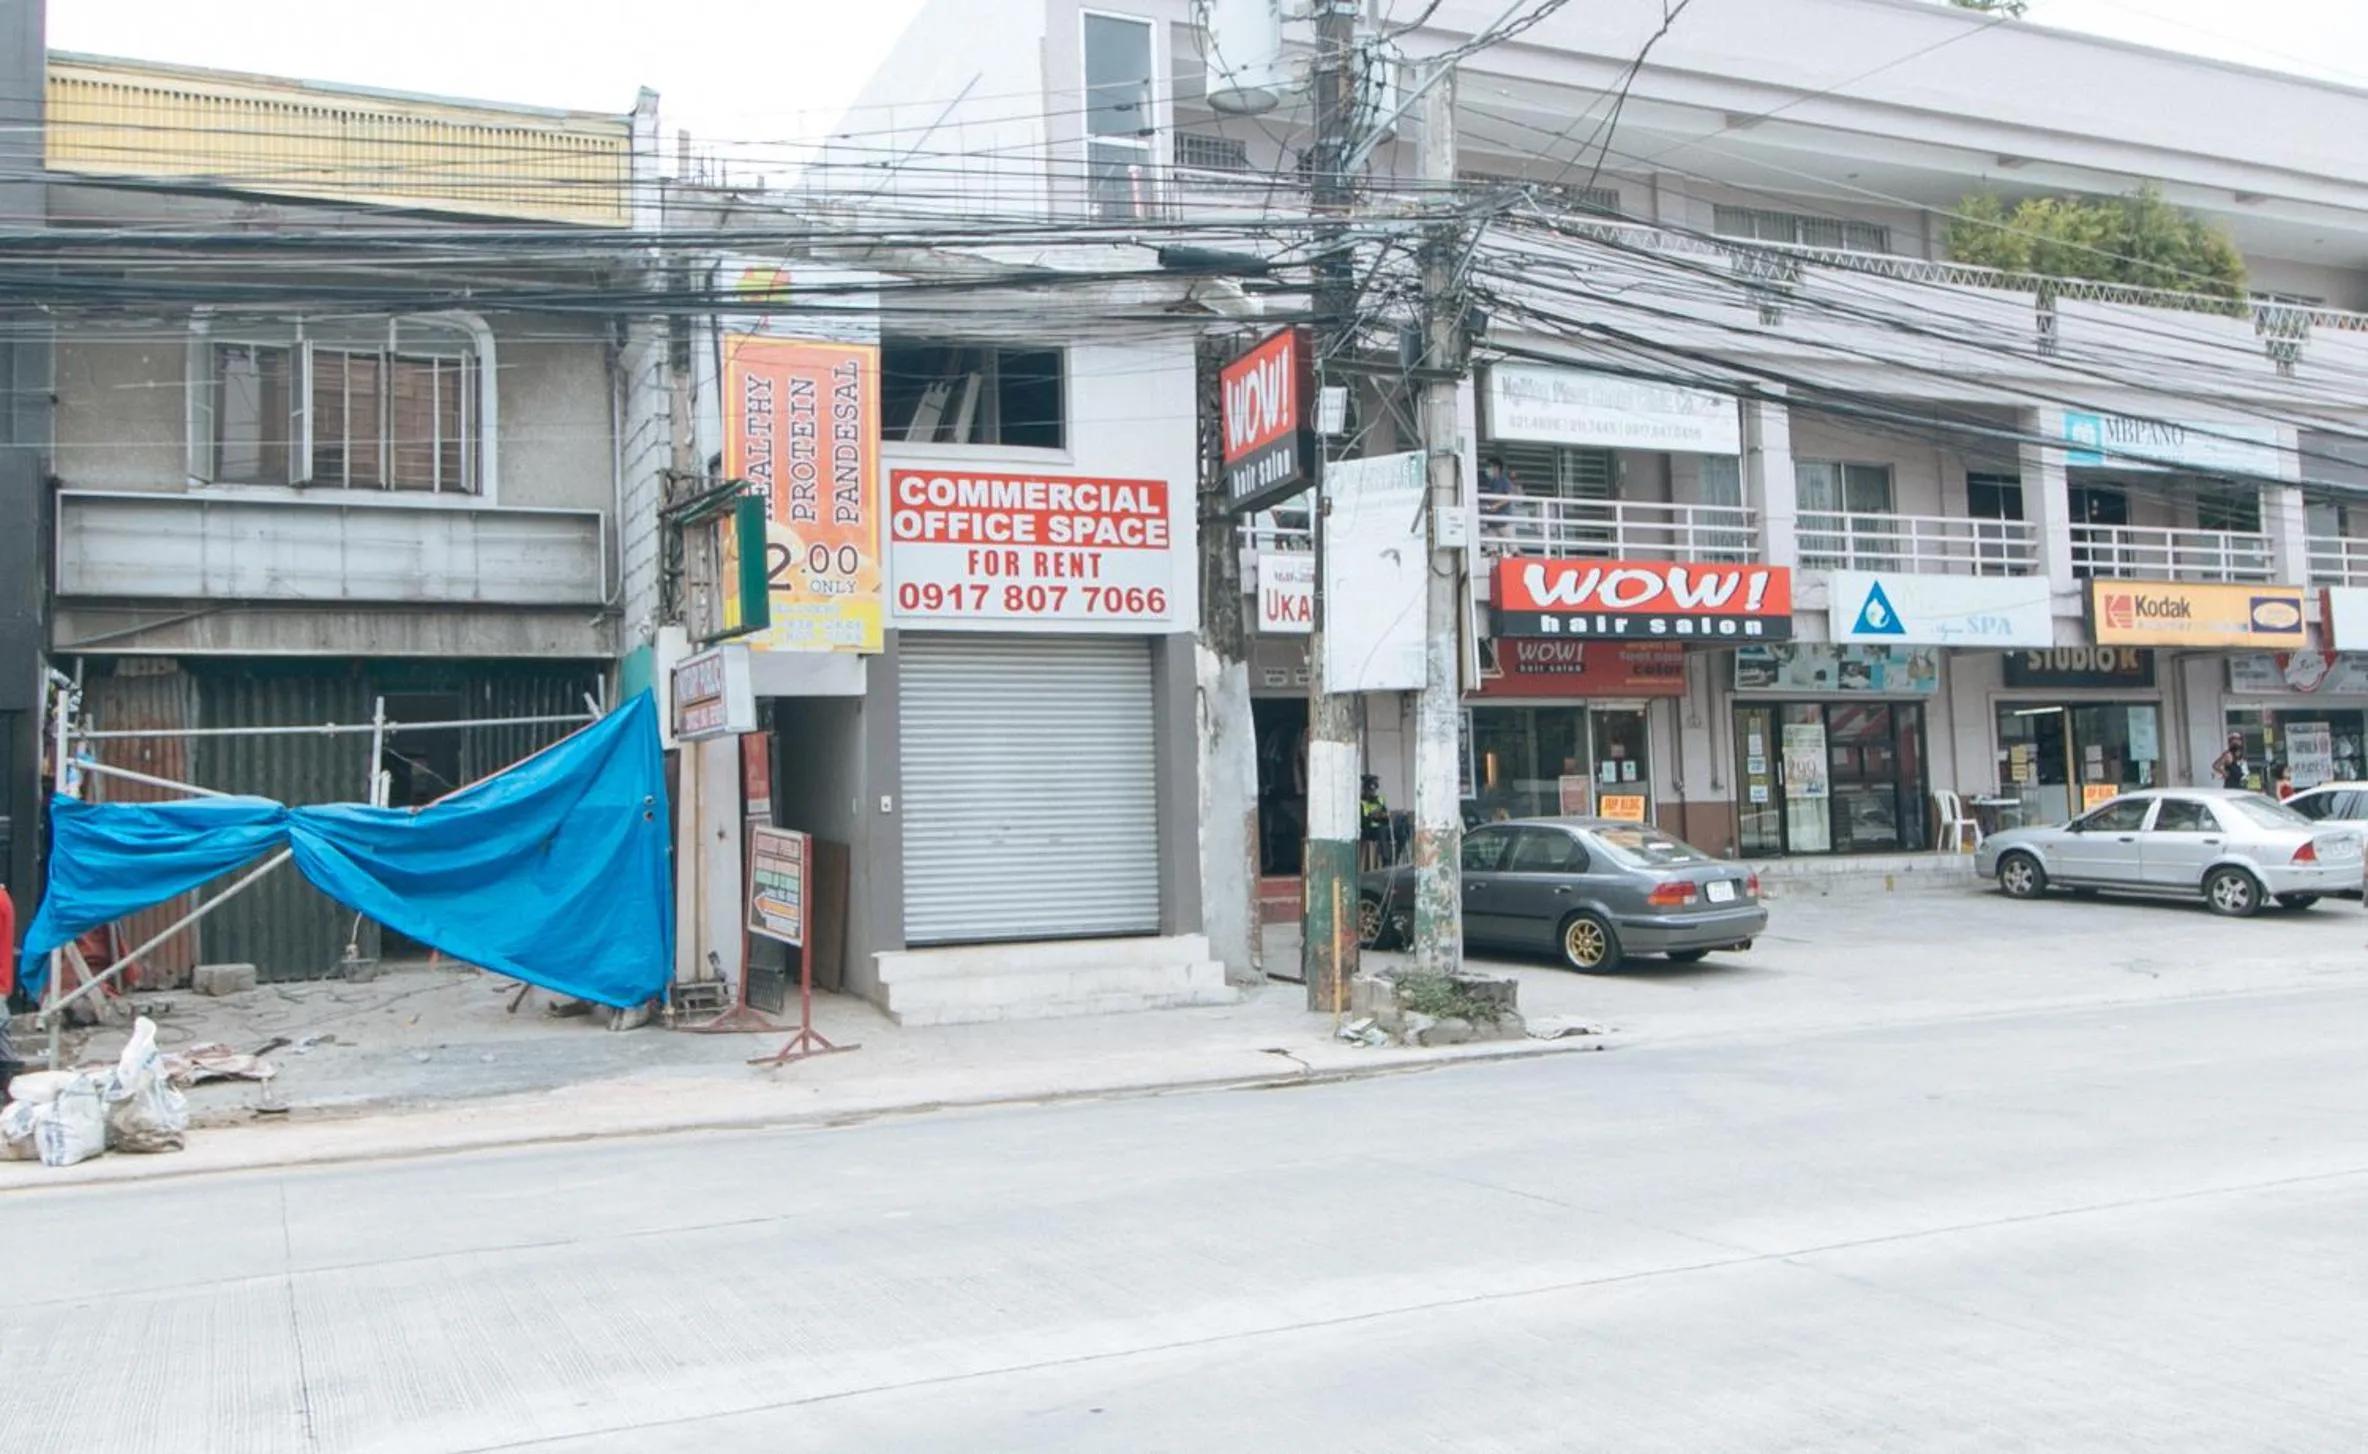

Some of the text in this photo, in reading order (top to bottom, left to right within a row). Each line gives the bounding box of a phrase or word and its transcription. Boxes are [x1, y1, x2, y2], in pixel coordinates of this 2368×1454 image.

[1225, 346, 1290, 453] WOW!
[747, 374, 773, 521] EALTHY
[790, 377, 816, 523] PROTEIN
[834, 361, 860, 524] PANDESAL
[1233, 447, 1291, 500] hair salon
[899, 476, 1160, 515] COMMERCIAL
[893, 510, 1168, 546] OFFICE SPACE
[968, 549, 1102, 579] FOR RENT
[810, 579, 857, 595] ONLY
[898, 582, 1166, 614] 0917 807 7066
[1522, 563, 1770, 612] WOW!
[2134, 595, 2192, 620] Kodak
[1540, 614, 1764, 636] hair salon
[1966, 615, 2013, 636] SPA
[1516, 641, 1584, 663] WOW!
[2026, 646, 2116, 673] STUDIO
